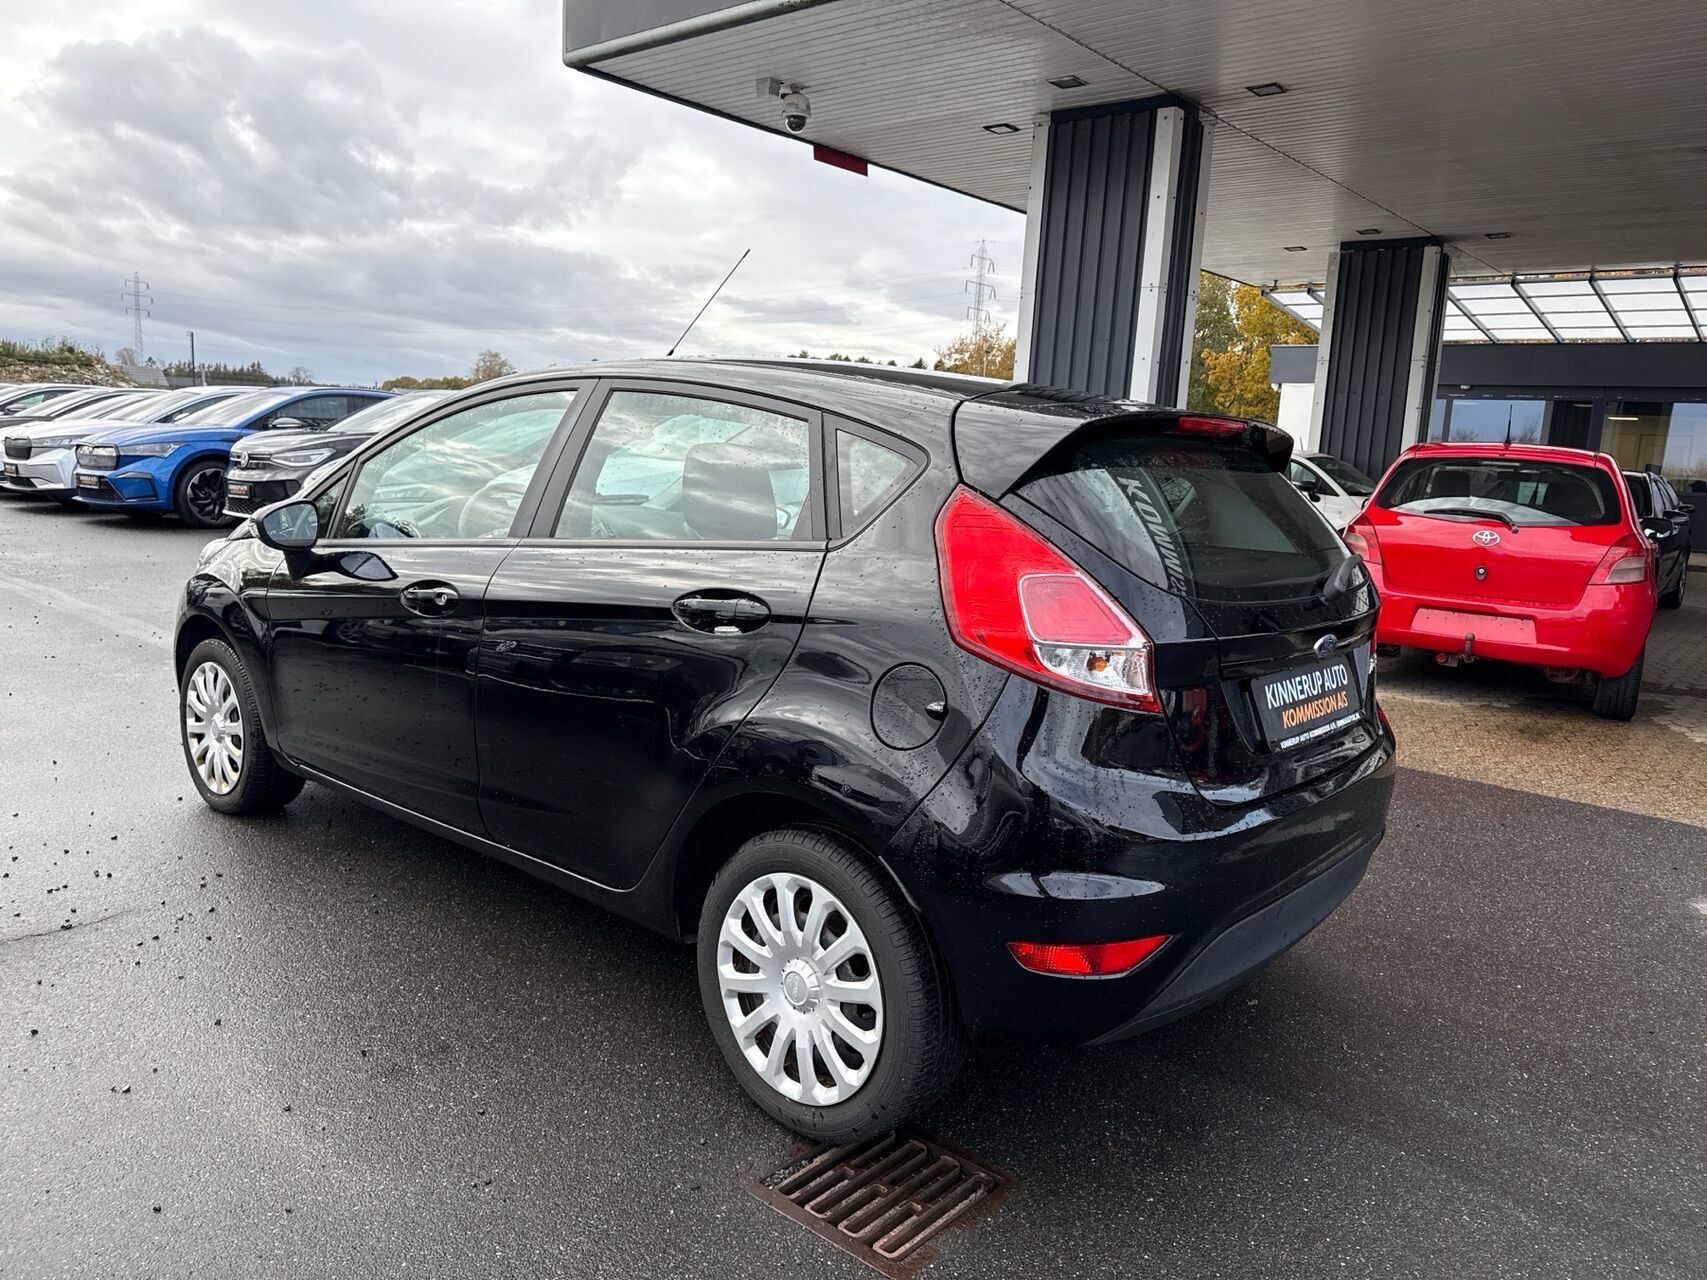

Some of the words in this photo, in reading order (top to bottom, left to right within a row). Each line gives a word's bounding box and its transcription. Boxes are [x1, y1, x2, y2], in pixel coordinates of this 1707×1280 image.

[1264, 671, 1322, 710] KINNERUP
[1323, 664, 1348, 691] AUTO
[1282, 695, 1337, 729] KOMMISSION
